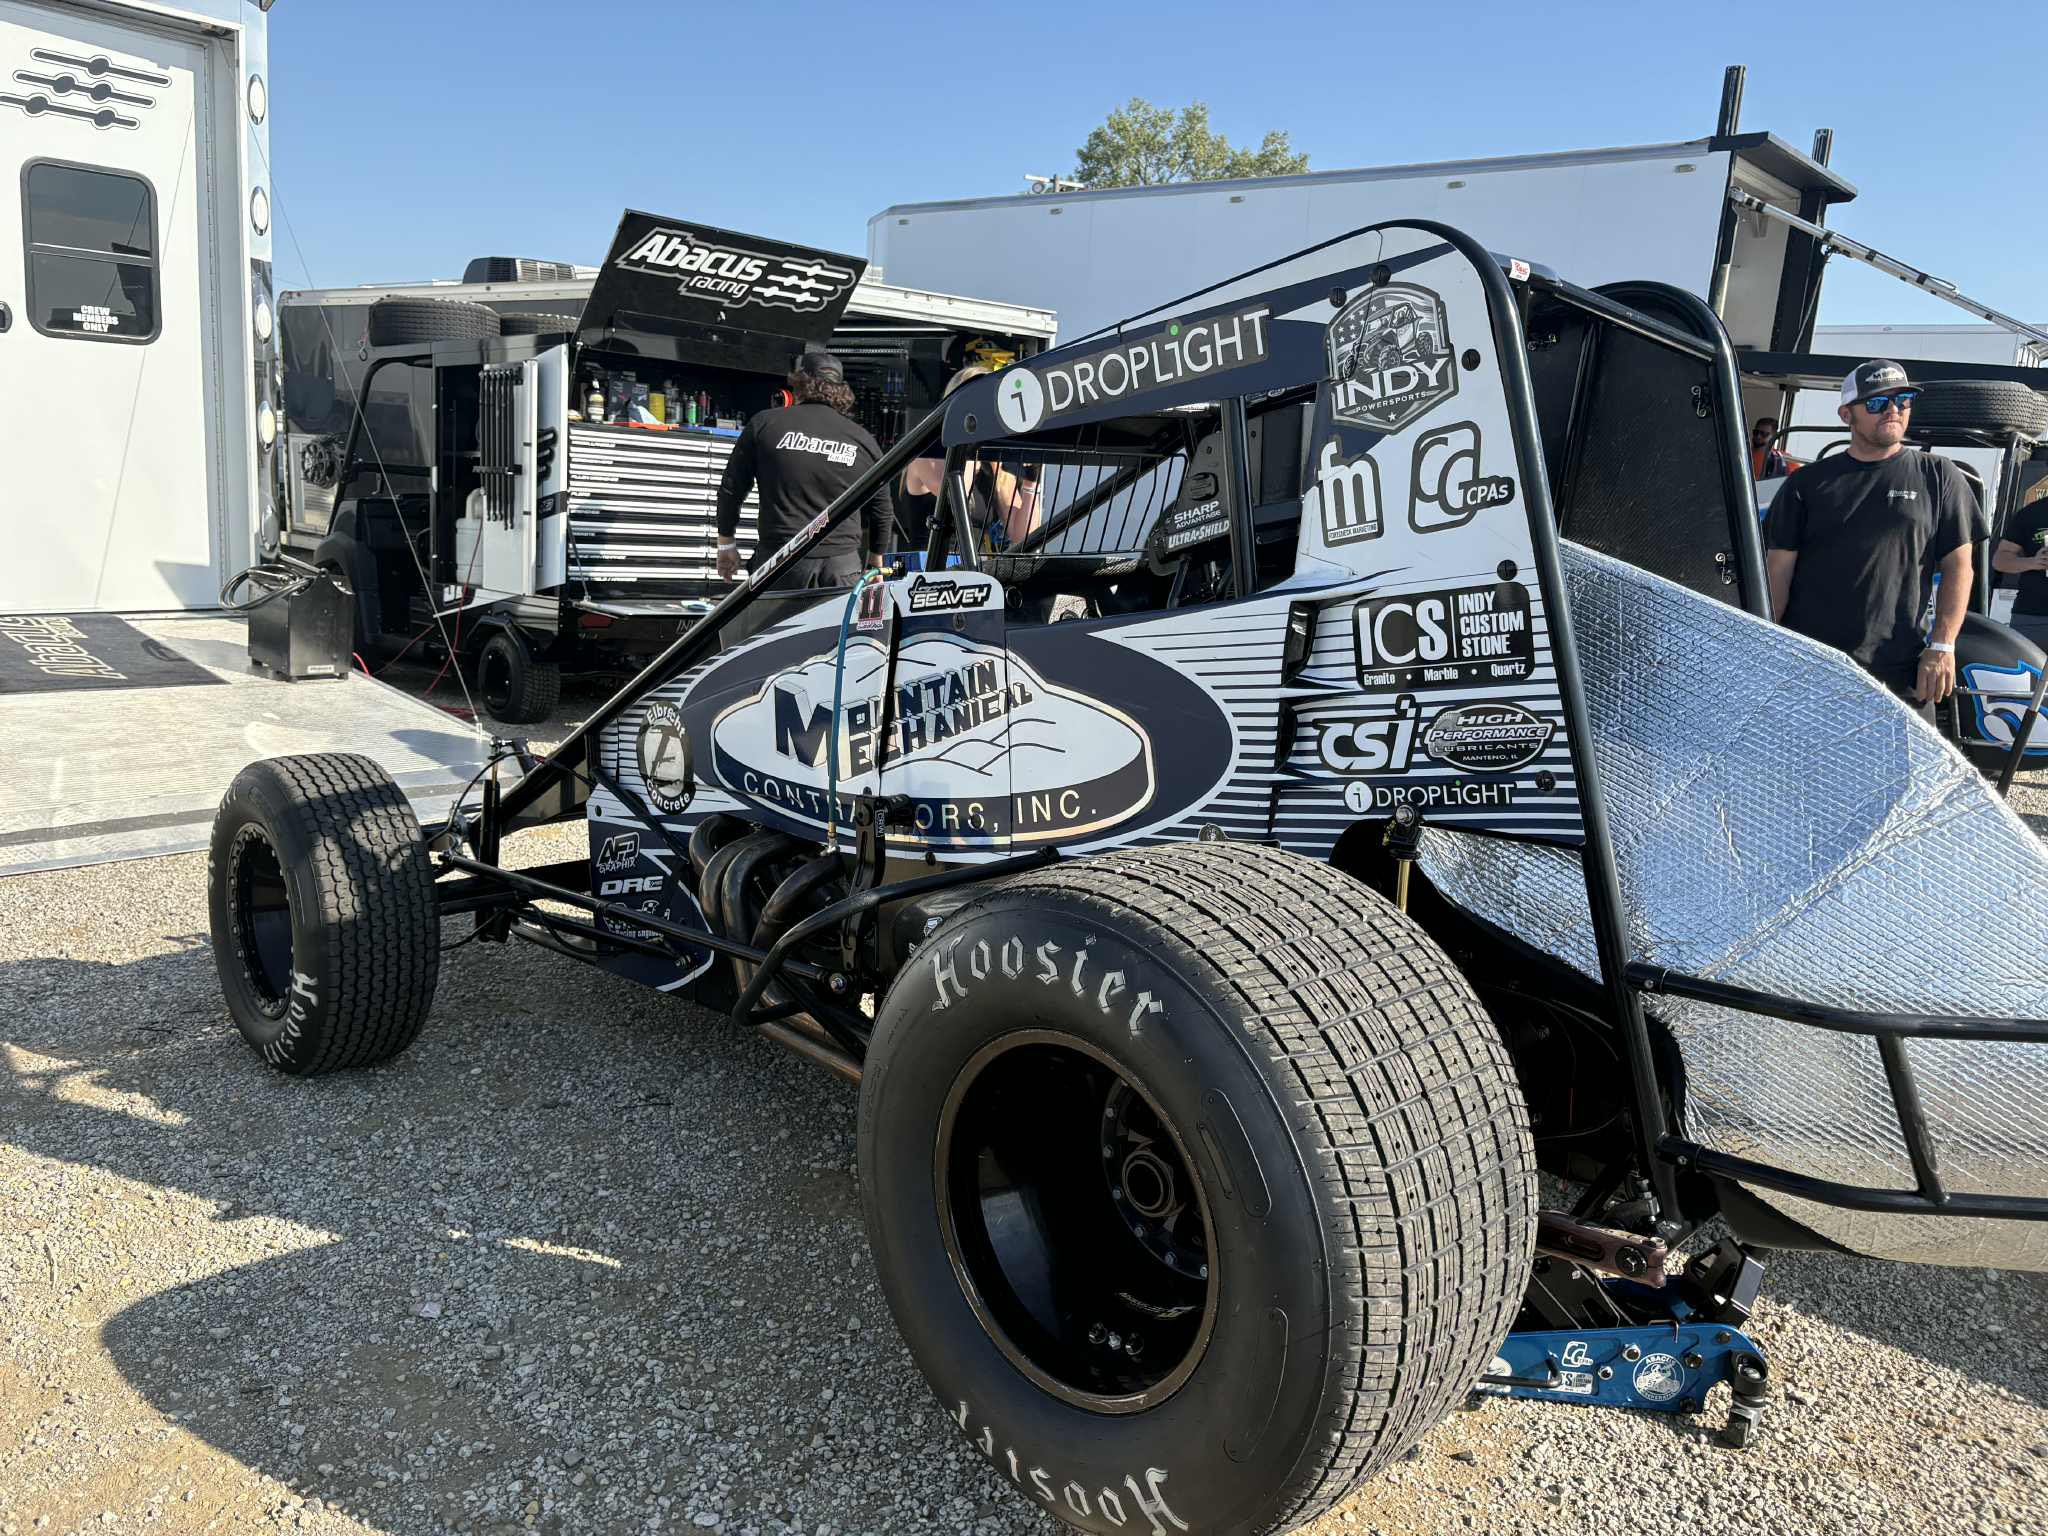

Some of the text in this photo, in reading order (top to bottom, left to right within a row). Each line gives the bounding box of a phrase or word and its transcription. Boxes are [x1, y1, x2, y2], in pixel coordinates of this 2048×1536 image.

[629, 234, 769, 281] Abacus
[689, 275, 749, 298] racing
[72, 312, 119, 325] MEMBERS
[80, 305, 111, 316] CREW
[82, 321, 109, 333] ONLY
[1335, 357, 1449, 410] INDY
[1354, 392, 1426, 413] POWERSPORTS
[776, 431, 858, 458] Abacus
[1174, 500, 1219, 523] SHARP
[1176, 509, 1221, 529] ADVANTAGE
[912, 587, 988, 609] SEAVEY
[1458, 591, 1496, 614] INDY
[1358, 599, 1449, 666] ICS
[1459, 611, 1525, 635] CUSTOM
[1461, 634, 1512, 657] STONE
[1363, 662, 1527, 686] Granite Marble Quartz
[646, 703, 686, 738] Elbrecht
[1456, 713, 1524, 726] HIGH
[1431, 727, 1549, 742] PERFORMANCE
[1435, 743, 1539, 753] LUBRICANTS
[647, 778, 691, 811] Concrete
[744, 771, 1098, 833] CONTRORS, INC.
[931, 927, 1163, 1039] Hoosier
